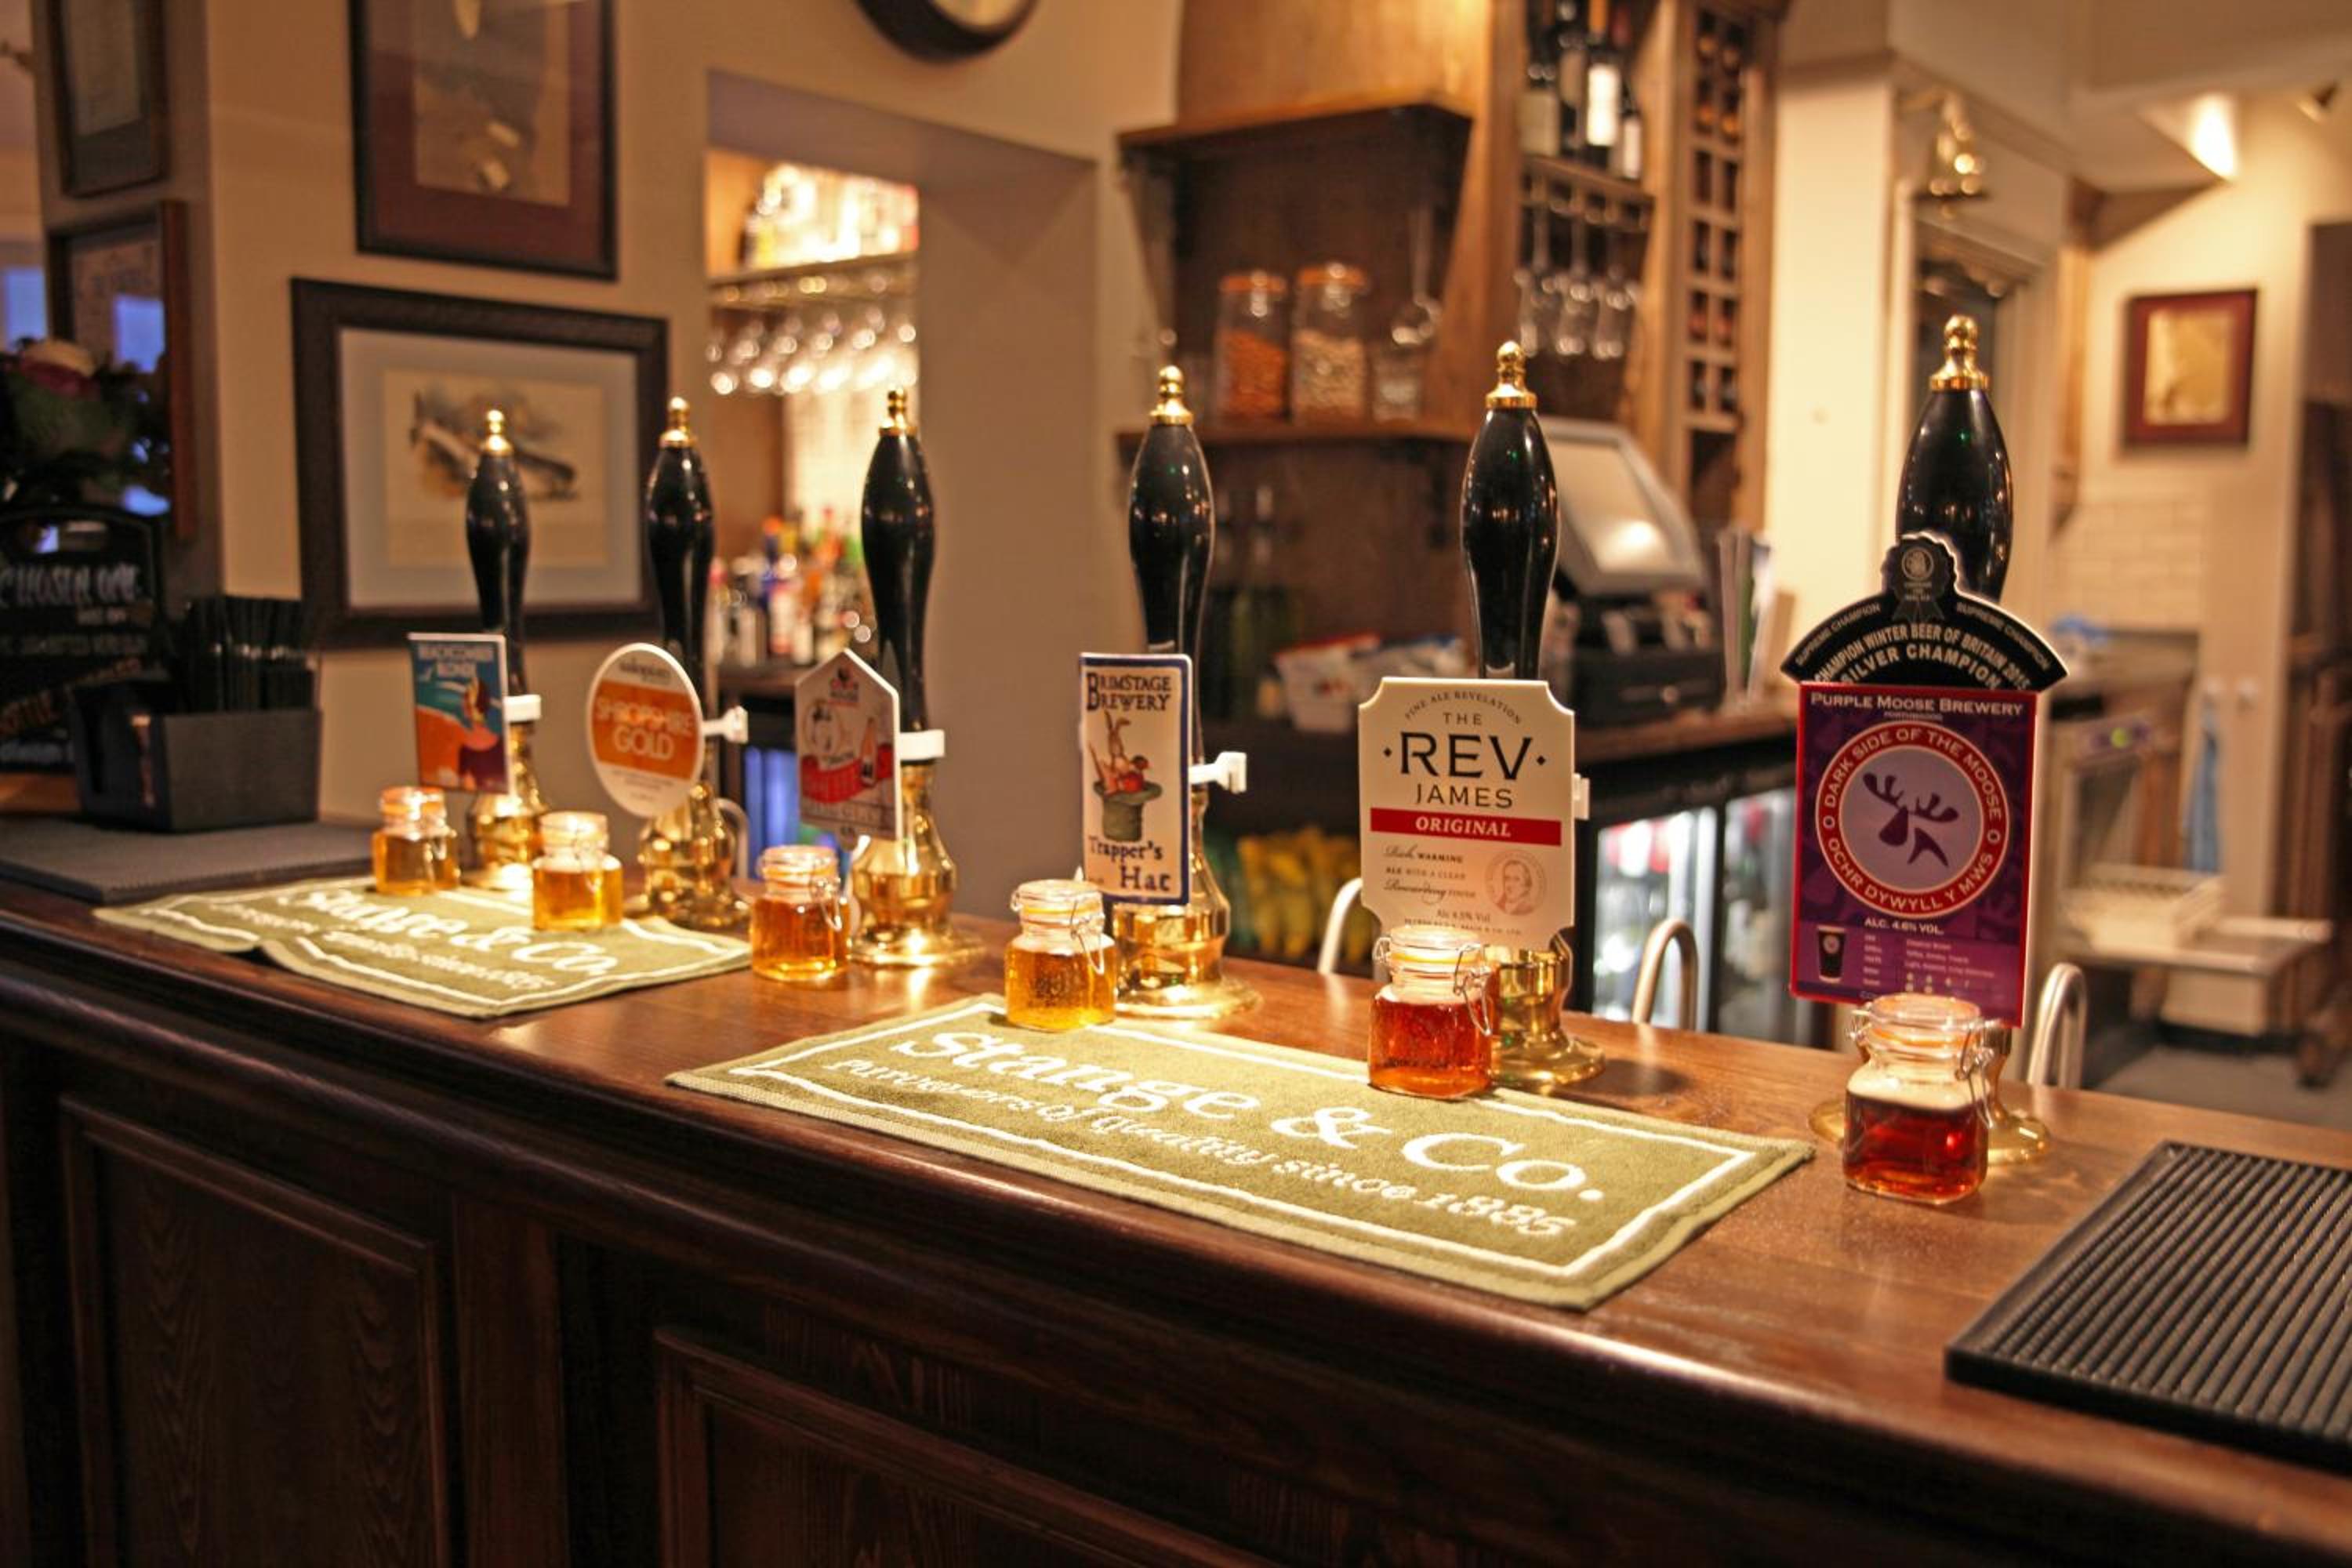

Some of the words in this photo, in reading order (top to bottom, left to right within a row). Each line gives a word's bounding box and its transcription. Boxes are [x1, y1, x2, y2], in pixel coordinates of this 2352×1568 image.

[1831, 602, 1880, 632] CHAMPION
[1814, 640, 1866, 681] CHAMPION
[1862, 624, 1909, 649] WINTER
[1911, 623, 1941, 641] BEER
[1944, 626, 1960, 644] OF
[1962, 633, 2007, 669] BRITAIN
[1841, 646, 1900, 684] SILVER
[1907, 644, 2001, 690] CHAMPION
[1404, 699, 1427, 720] FINE
[1431, 692, 1450, 705] ALE
[1454, 691, 1523, 725] REVELATION
[1443, 711, 1483, 727] THE
[1810, 691, 1873, 708] PURPLE
[1878, 695, 1935, 712] MOOSE
[1940, 698, 2024, 717] BREWERY
[613, 726, 675, 760] GOLD
[1399, 730, 1534, 781] REV
[1825, 759, 1855, 808] DARK
[1852, 731, 1893, 756] SIDE
[1896, 728, 1922, 742] OF
[1927, 730, 1965, 755] THE
[1963, 753, 2002, 821] MOOSE
[1415, 783, 1514, 810] JAMES
[1415, 815, 1512, 837] ORIGINAL
[1087, 836, 1163, 862] Trapper's
[1417, 851, 1464, 864] WARMING
[1828, 837, 1866, 889] OCHR
[1864, 886, 1944, 912] DYWYLL
[1945, 890, 1957, 902] Y
[1958, 852, 1994, 895] MWS
[1864, 916, 1889, 929] ALC.
[1919, 924, 1945, 936] VOL.
[888, 1032, 1261, 1120] Stange
[1270, 1105, 1394, 1149] &
[1403, 1132, 1606, 1200] Co.
[1036, 1101, 1120, 1123] of
[1272, 1159, 1417, 1200] since
